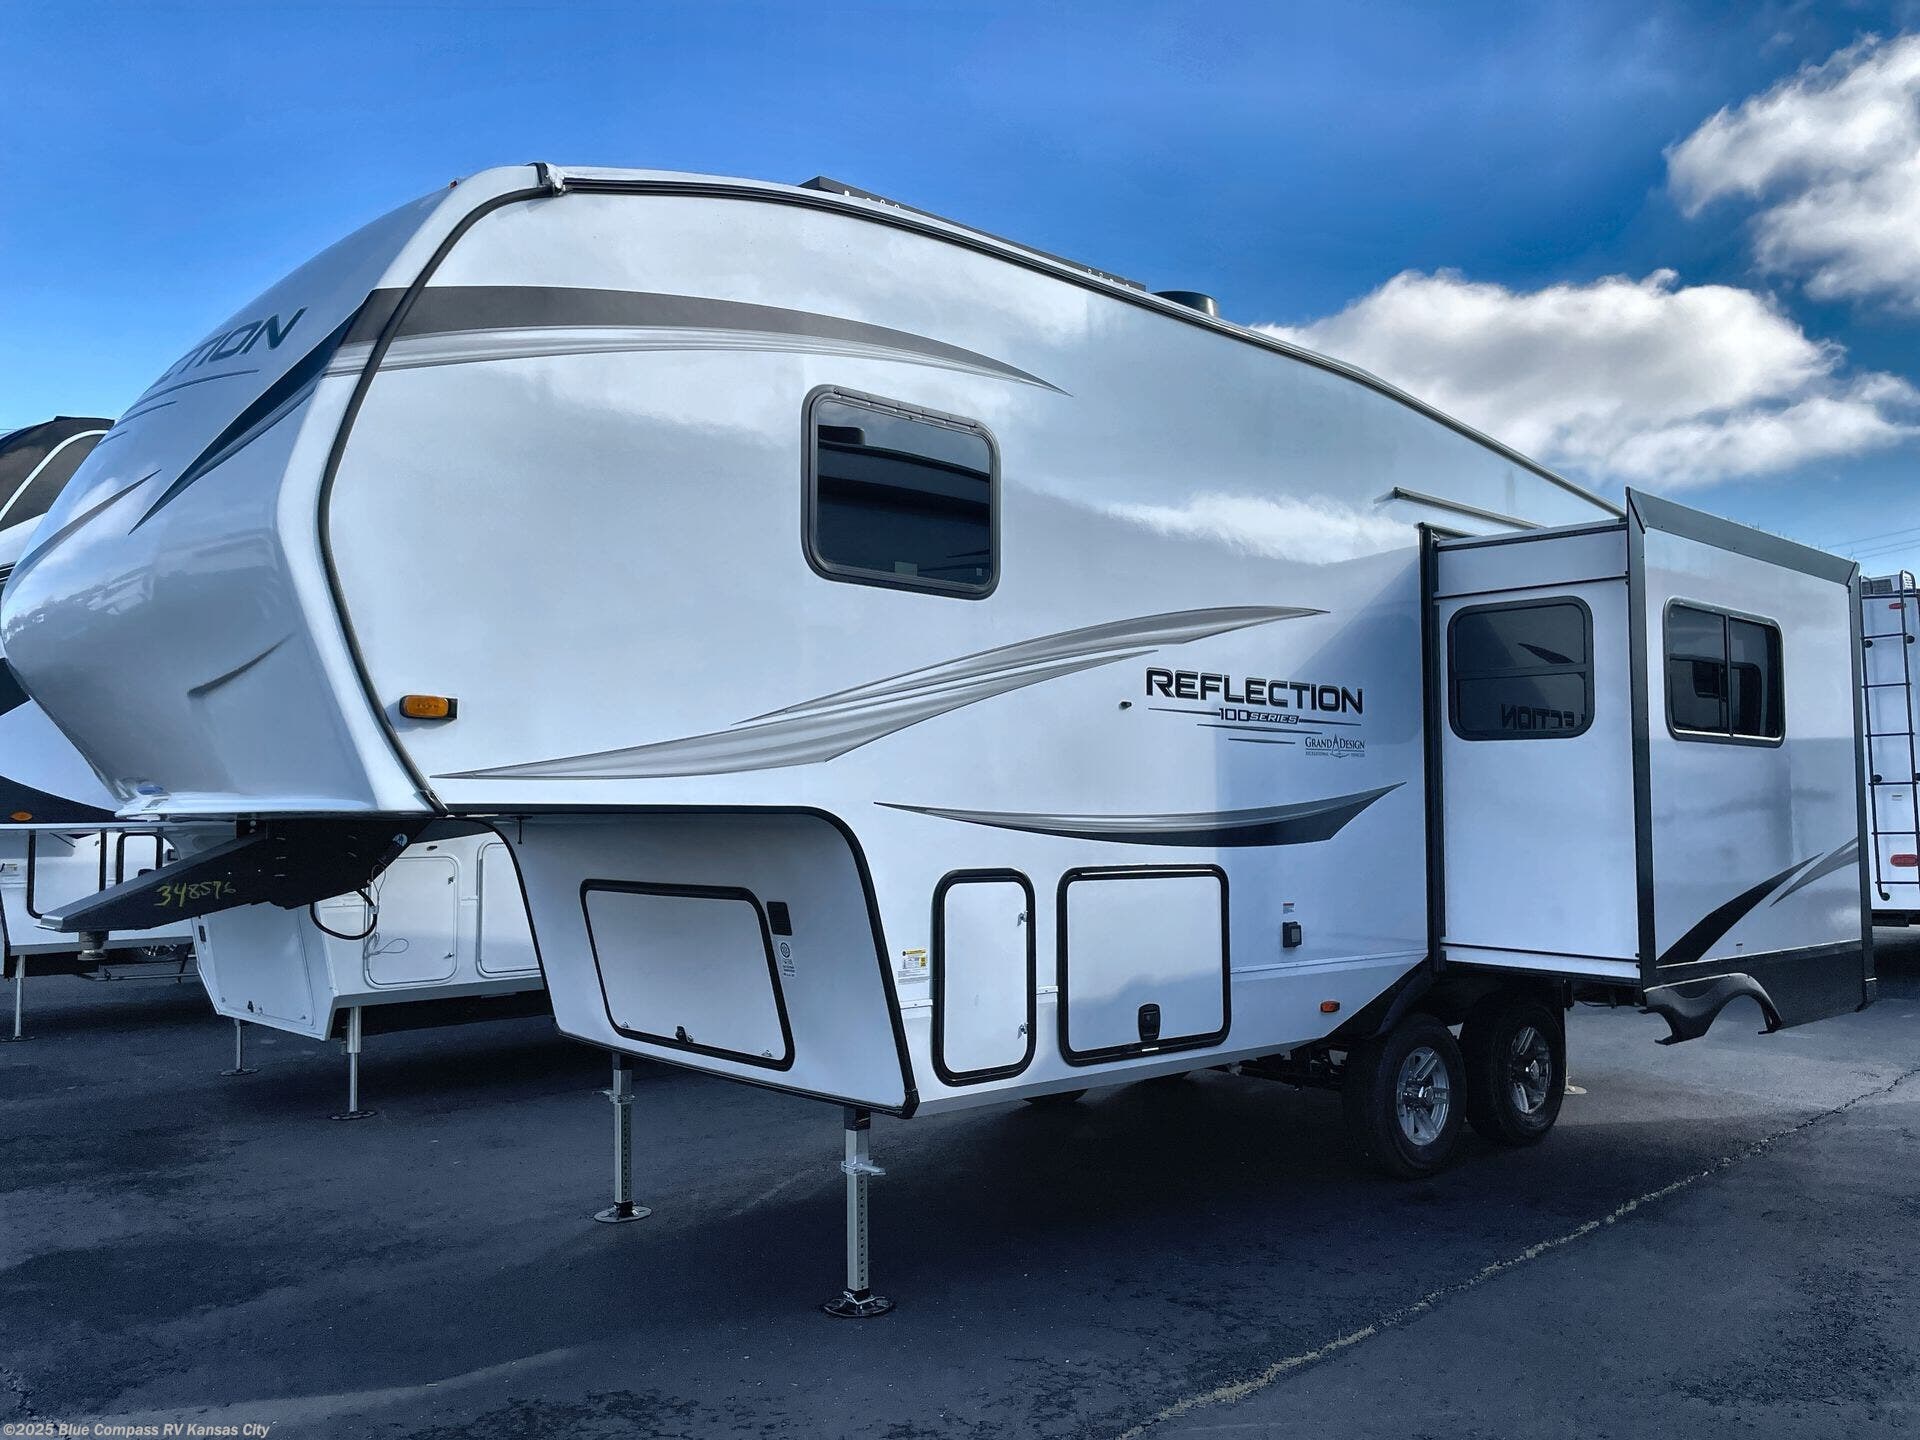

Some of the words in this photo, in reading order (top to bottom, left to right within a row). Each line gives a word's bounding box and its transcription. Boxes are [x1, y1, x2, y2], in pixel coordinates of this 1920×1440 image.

[1146, 667, 1363, 714] REFLECTION
[1219, 708, 1249, 721] 100
[1249, 711, 1299, 724] SERIES
